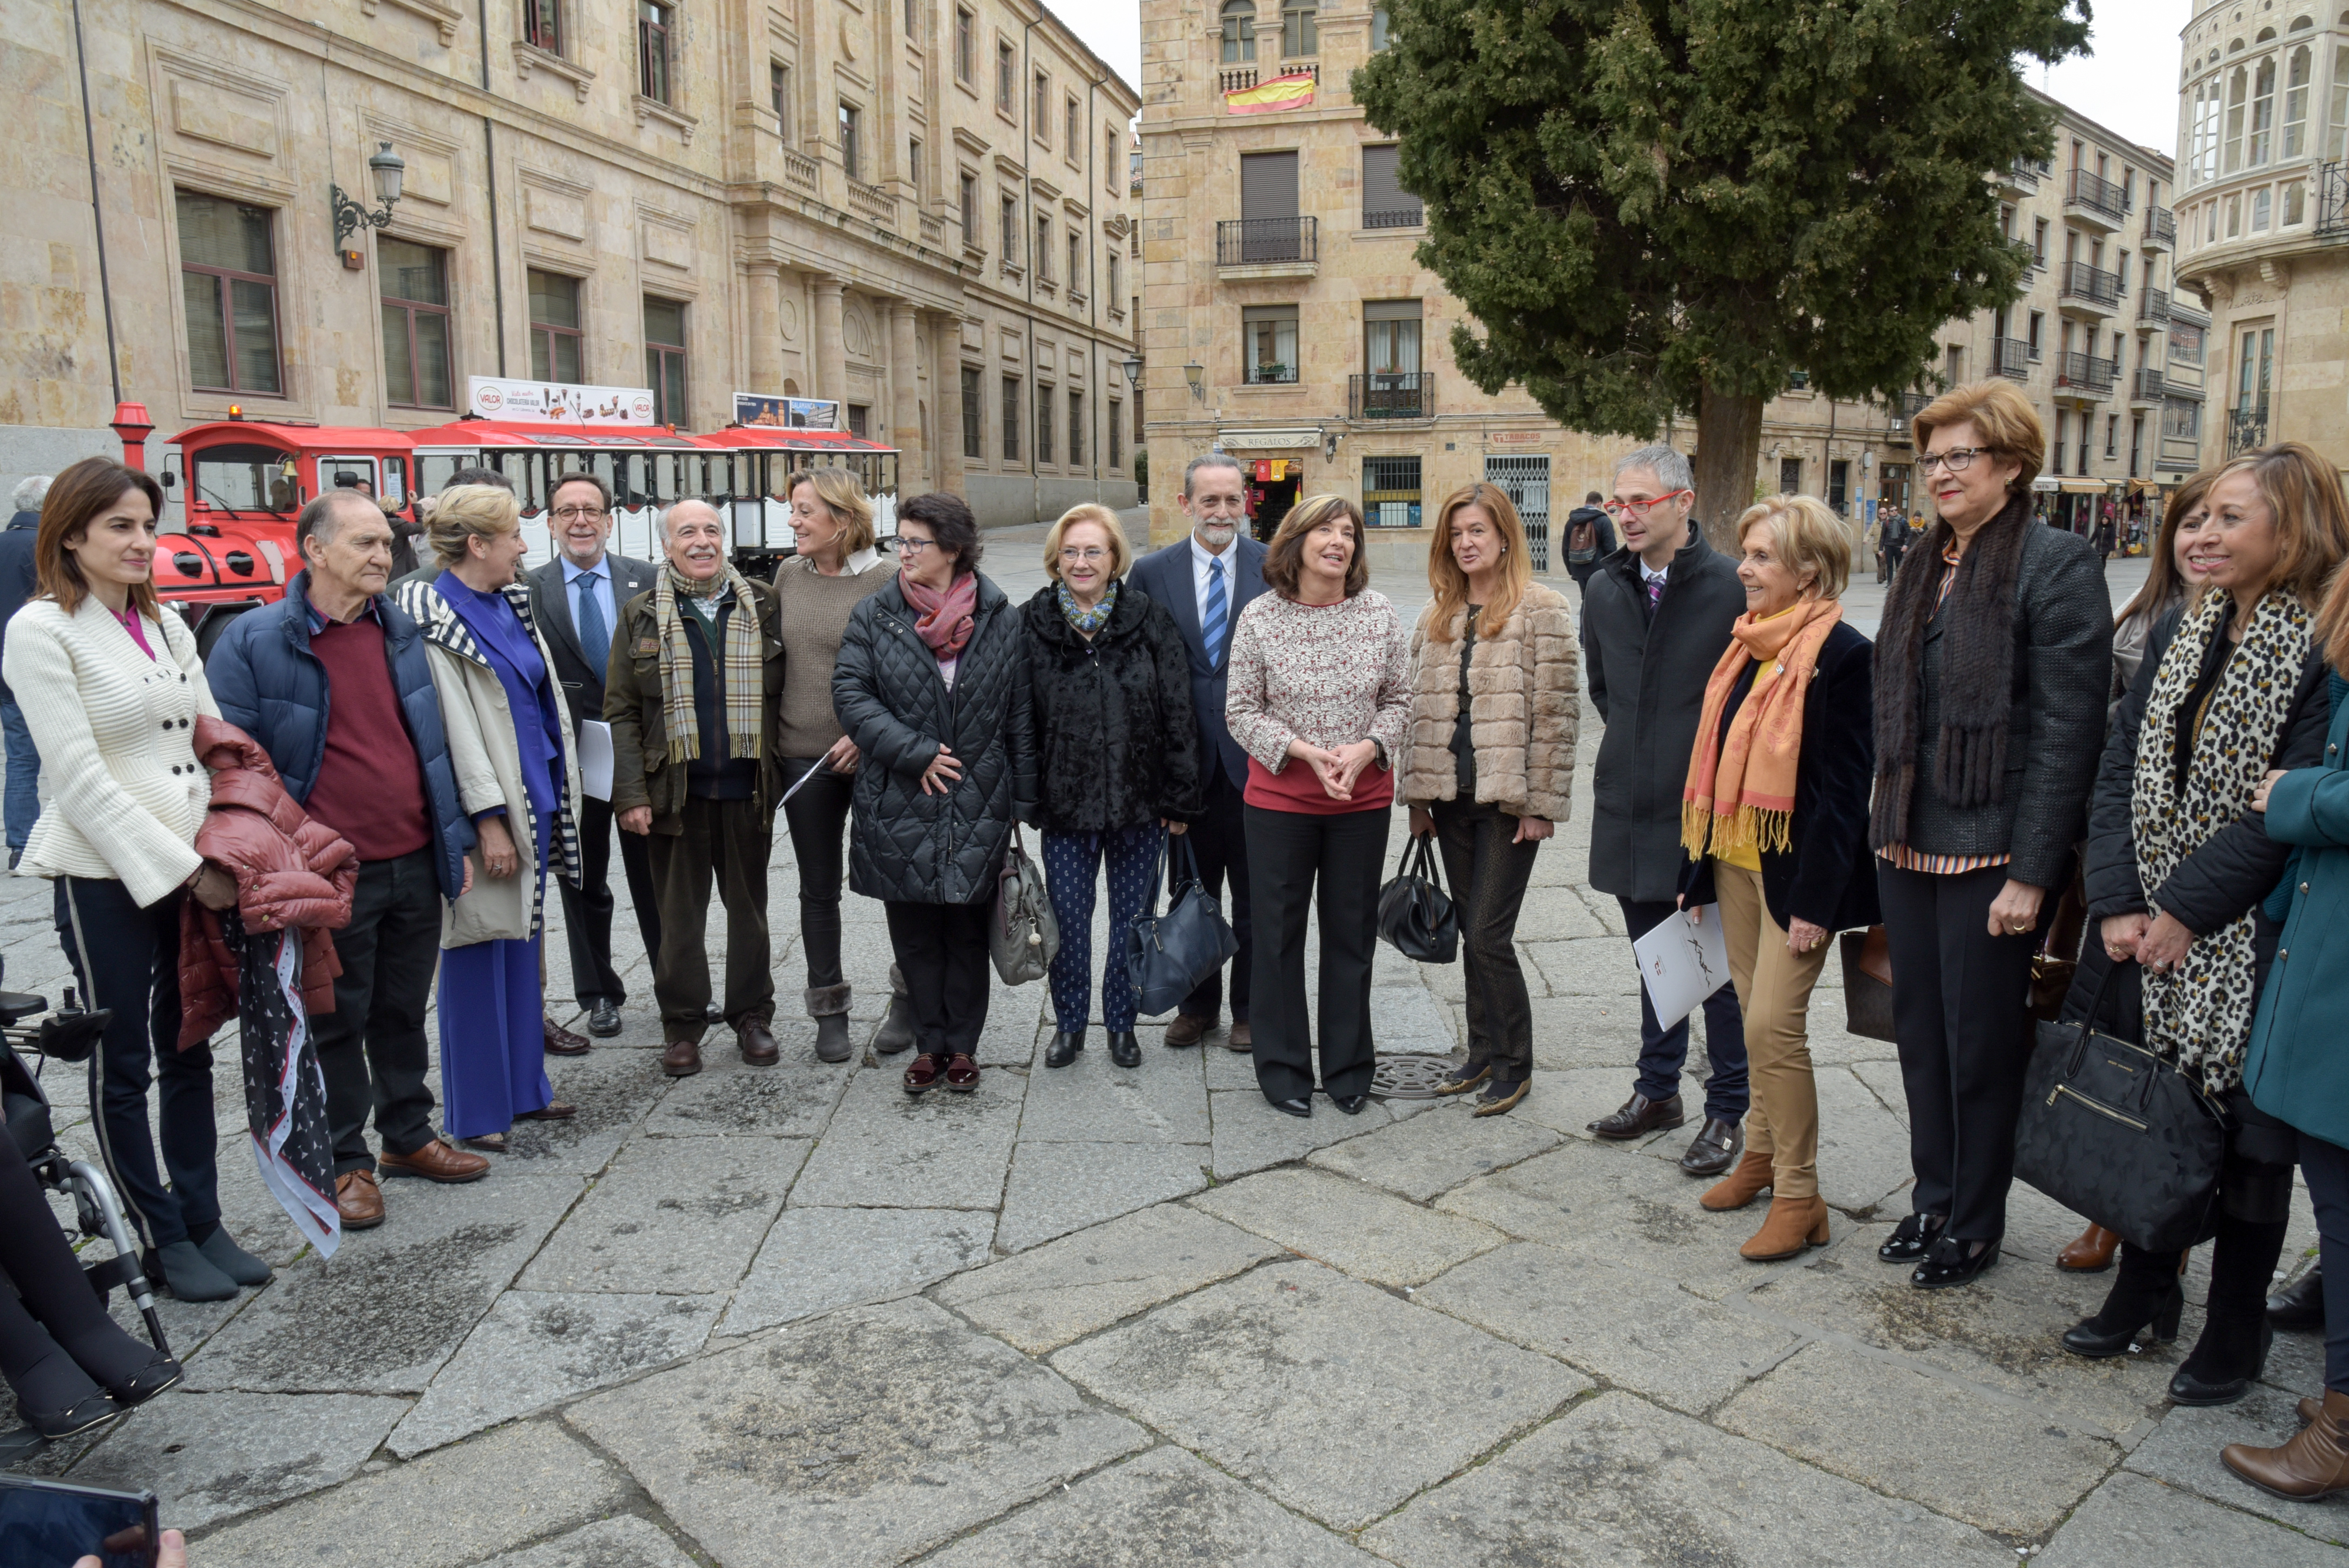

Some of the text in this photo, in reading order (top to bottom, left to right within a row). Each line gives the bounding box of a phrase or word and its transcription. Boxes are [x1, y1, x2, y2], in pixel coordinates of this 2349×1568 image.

[480, 394, 500, 403] VALOR
[792, 402, 815, 410] SALAMANCA
[1248, 438, 1291, 446] REGALOS
